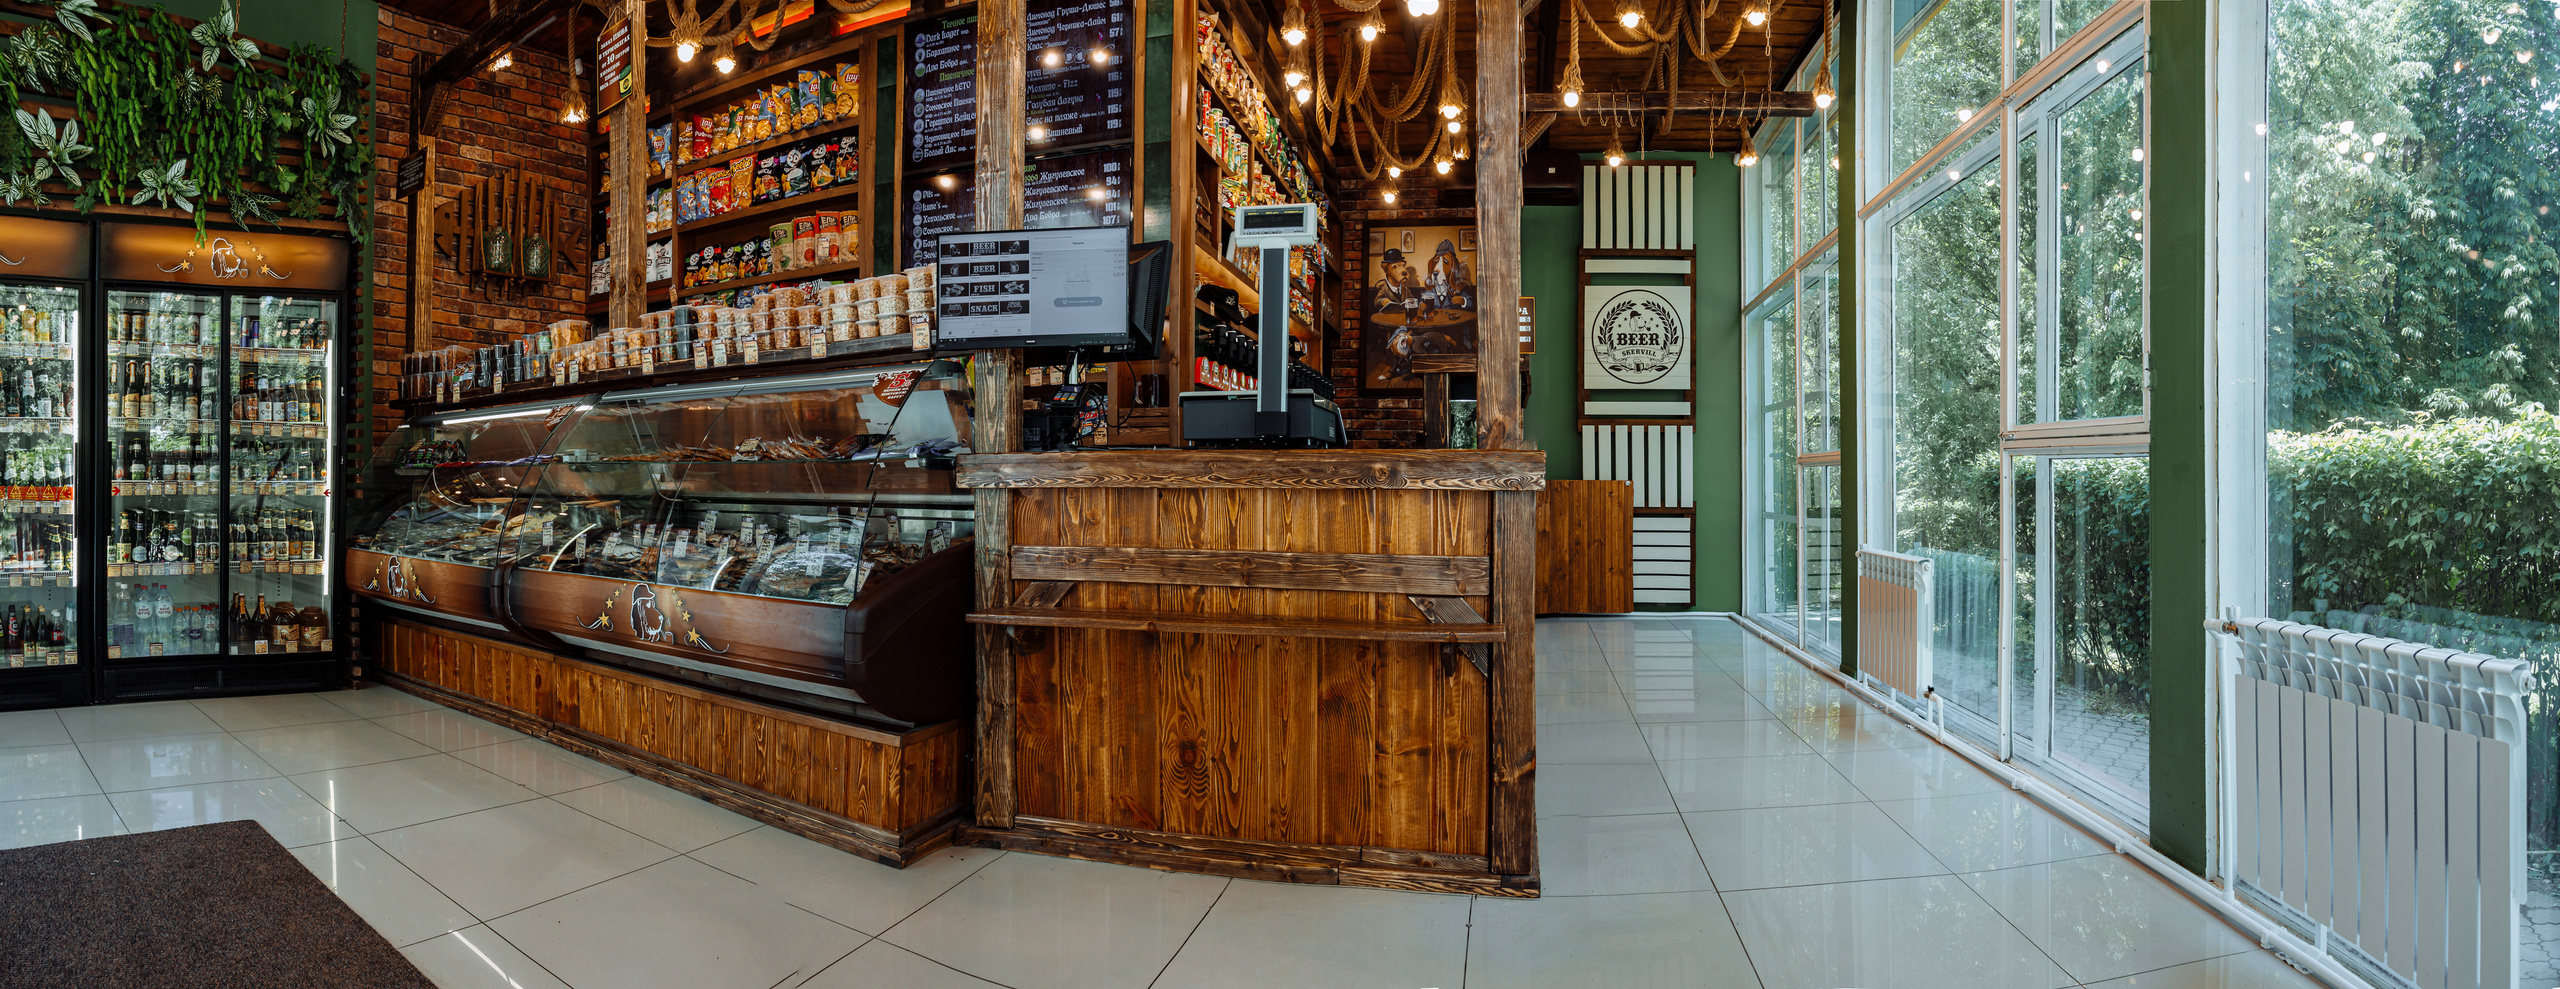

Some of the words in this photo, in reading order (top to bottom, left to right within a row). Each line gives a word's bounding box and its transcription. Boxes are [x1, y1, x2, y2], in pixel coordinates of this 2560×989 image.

[1027, 10, 1055, 21] Лимонад
[1027, 26, 1055, 36] Лимонад
[926, 32, 940, 42] Dark
[1027, 43, 1043, 51] Квас
[940, 68, 974, 82] Пшеничное
[1027, 83, 1056, 94] Мохито
[1058, 95, 1084, 106] Лагуна
[1046, 124, 1083, 138] Вишневый
[1104, 162, 1116, 173] 100
[1040, 168, 1085, 180] Жигулевское
[1025, 185, 1068, 196] Жигулевское
[1024, 198, 1068, 209] Жигулевское
[1024, 213, 1037, 222] Два
[1040, 211, 1060, 220] Бобра
[973, 265, 995, 273] BEER
[974, 284, 995, 292] FISH
[1617, 333, 1660, 346] BEER
[1622, 349, 1657, 357] SKERVILL
